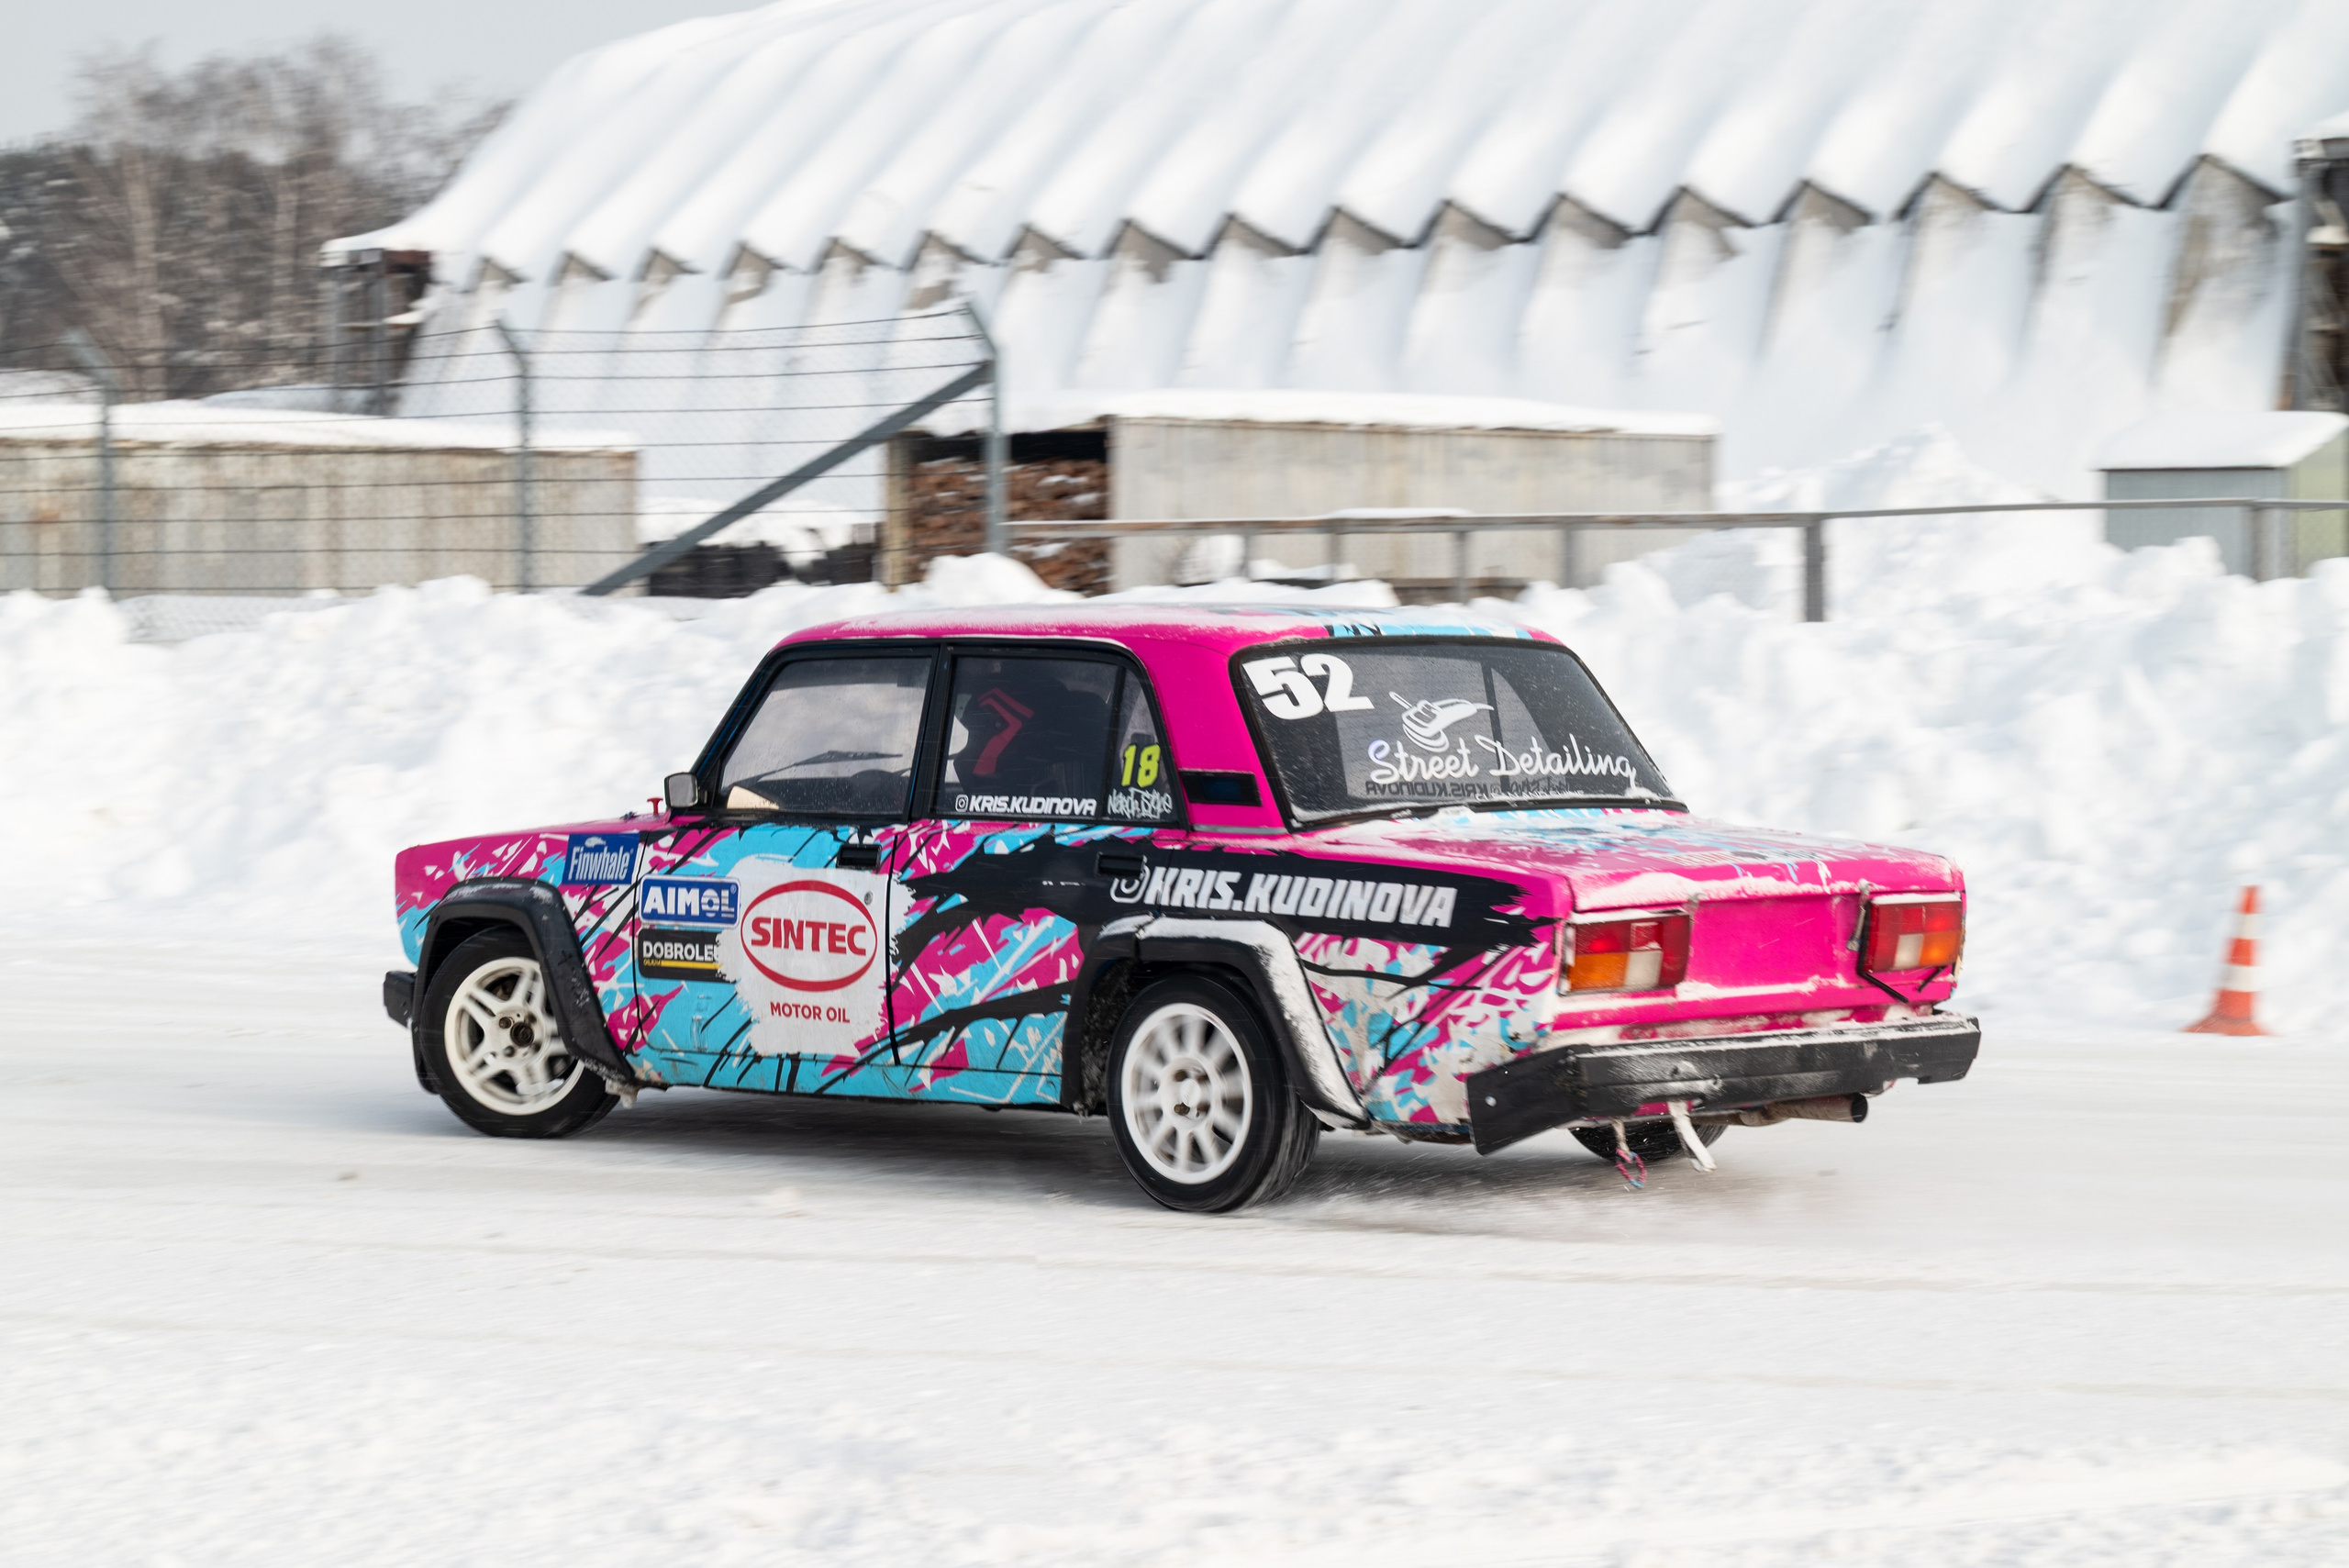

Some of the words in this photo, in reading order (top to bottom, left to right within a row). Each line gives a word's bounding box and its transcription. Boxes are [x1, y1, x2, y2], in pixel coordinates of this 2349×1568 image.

[1241, 653, 1375, 720] 52
[1121, 744, 1161, 788] 18
[1367, 737, 1479, 784] Street
[1475, 733, 1637, 789] Detailing
[969, 795, 1097, 817] KRIS.KUDINOVA
[567, 845, 630, 881] Finwhale
[642, 885, 735, 918] AIMOL
[1143, 865, 1458, 929] KRIS.KUDINOVA
[751, 916, 867, 957] SINTEC
[770, 1001, 822, 1021] MOTOR
[826, 1006, 851, 1024] OIL
